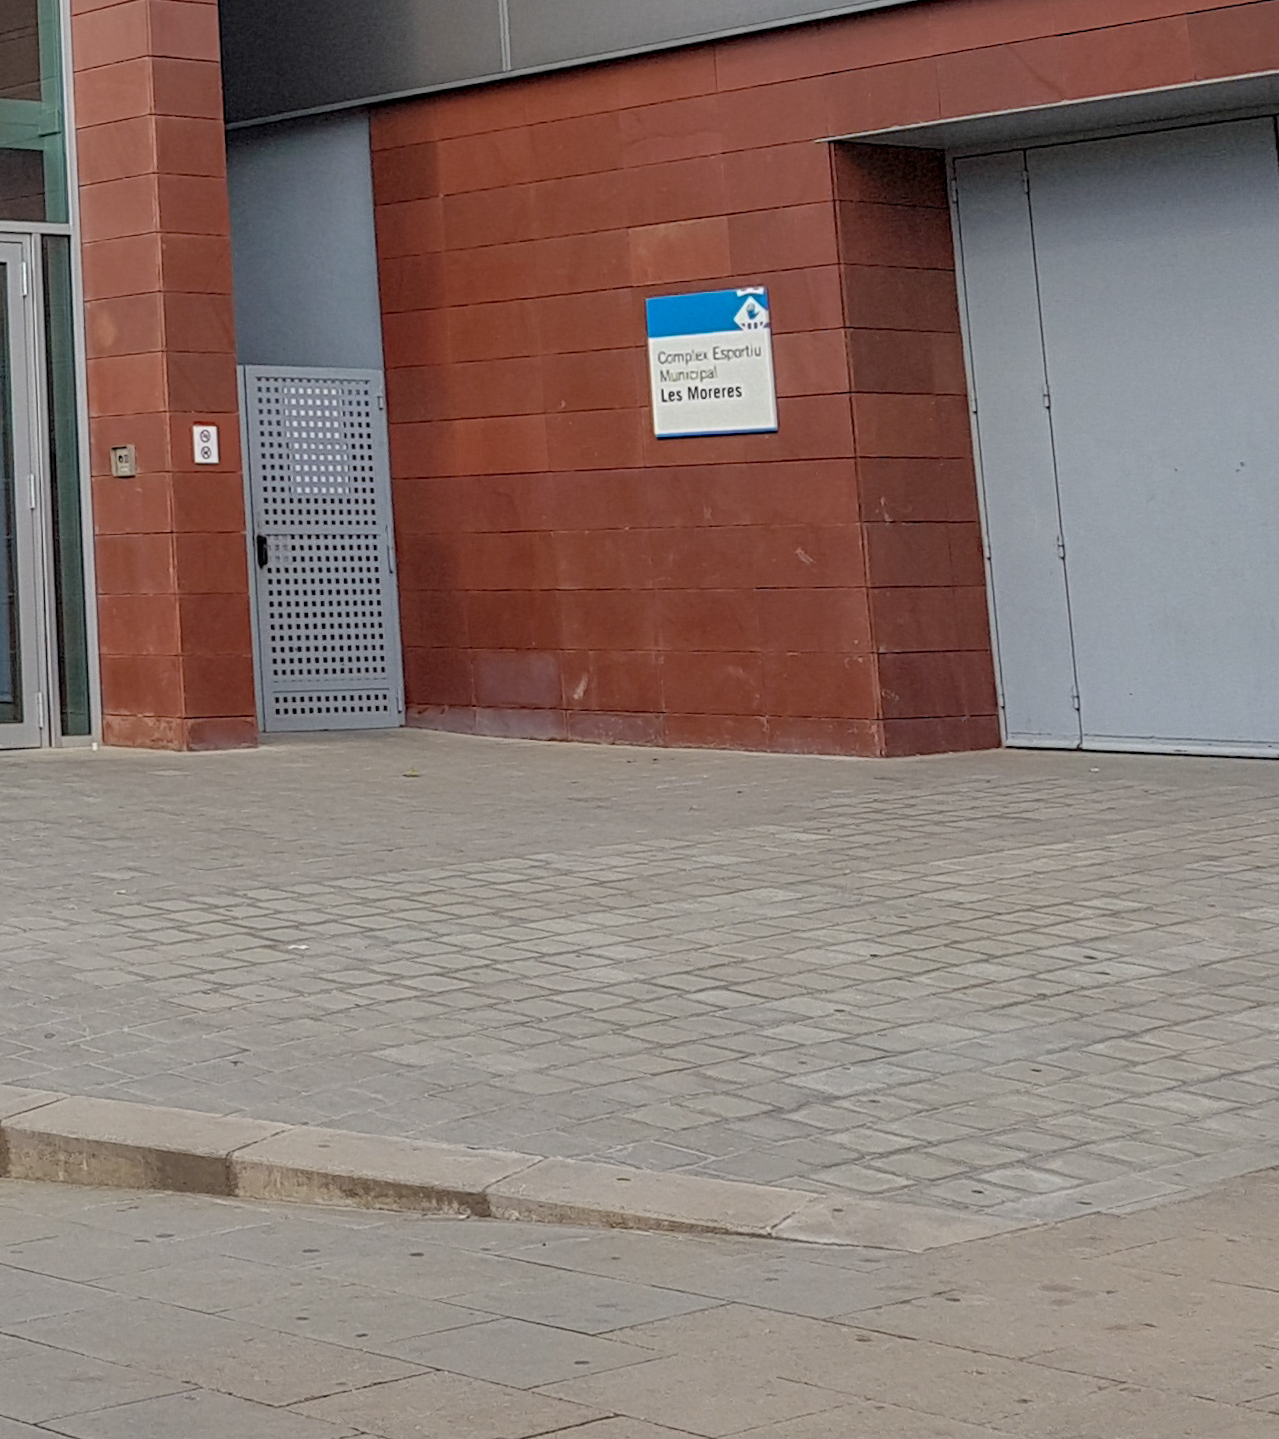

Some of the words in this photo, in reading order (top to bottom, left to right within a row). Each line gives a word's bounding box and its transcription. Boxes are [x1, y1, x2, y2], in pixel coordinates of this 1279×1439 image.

[657, 349, 708, 365] Complex
[712, 344, 762, 362] Esportiu
[659, 366, 718, 382] Municipal
[661, 388, 683, 403] Les
[687, 385, 743, 401] Moreres
